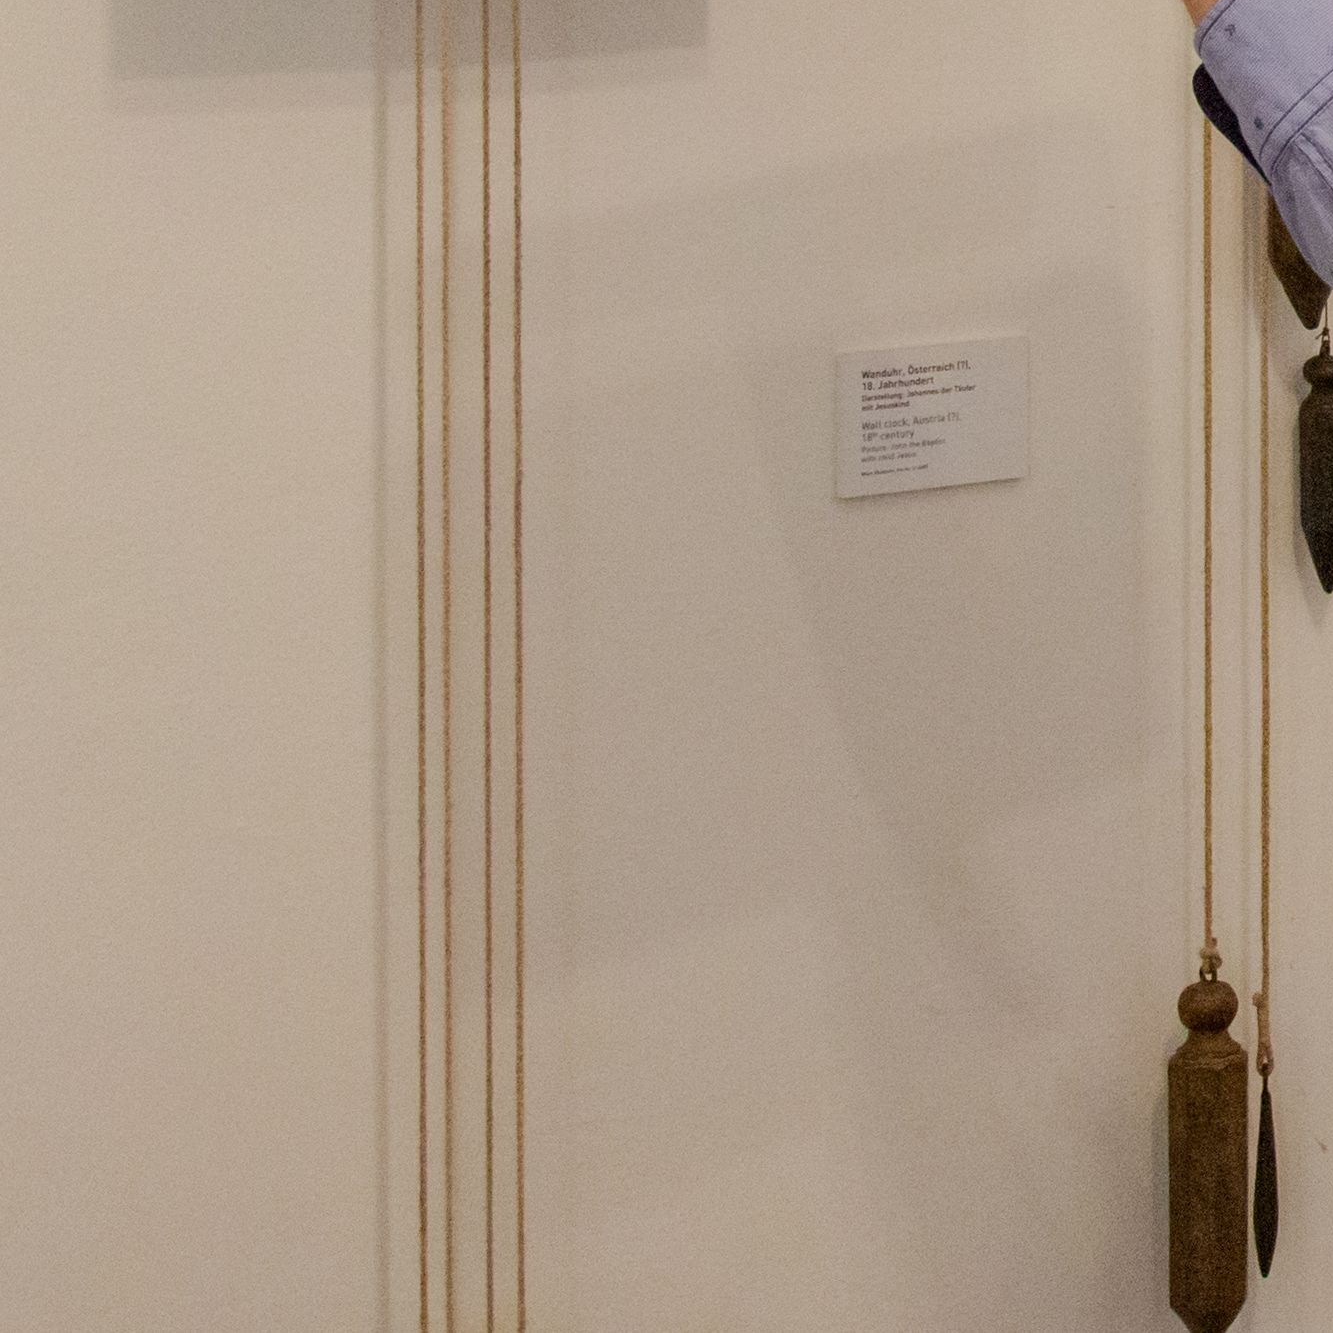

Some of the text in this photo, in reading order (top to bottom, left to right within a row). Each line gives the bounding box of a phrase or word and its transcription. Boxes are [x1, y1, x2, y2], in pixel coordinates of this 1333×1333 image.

[862, 368, 905, 379] Wanduhr,
[907, 364, 954, 375] Österreich
[863, 377, 934, 391] 18. Jahrhundert
